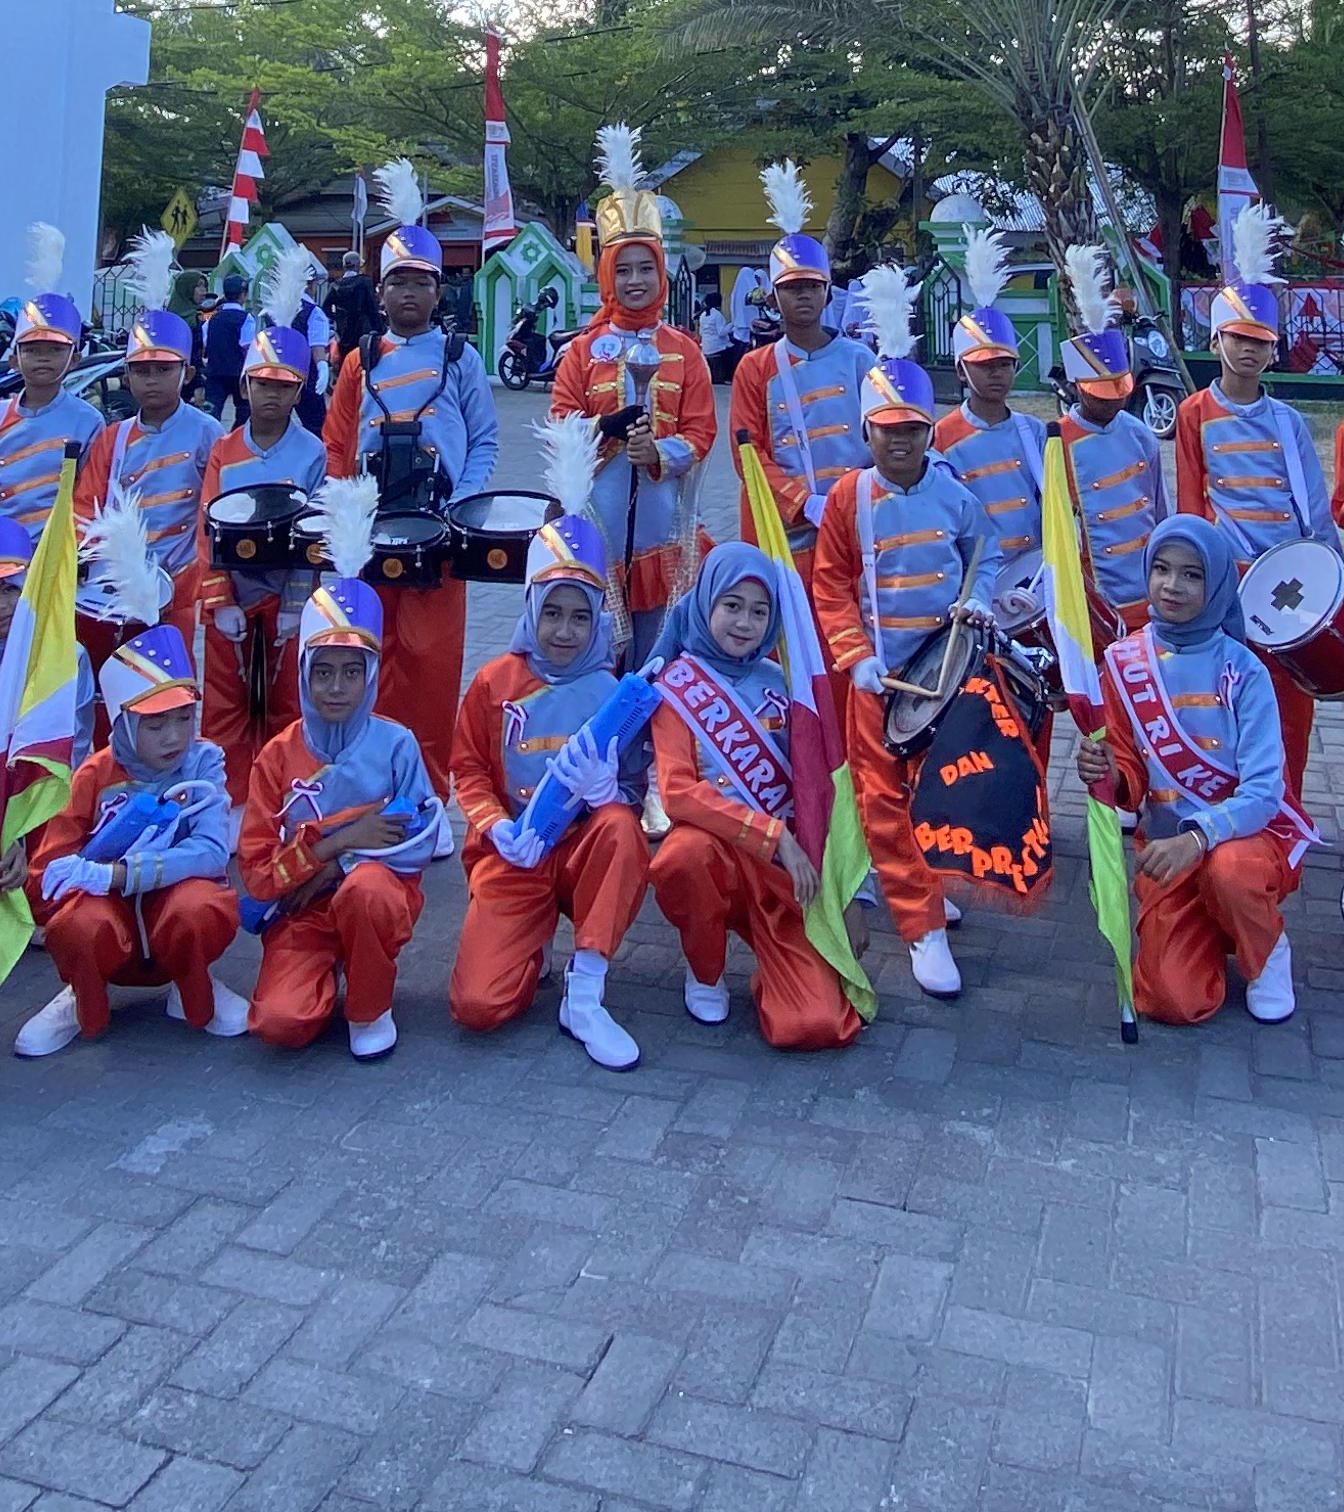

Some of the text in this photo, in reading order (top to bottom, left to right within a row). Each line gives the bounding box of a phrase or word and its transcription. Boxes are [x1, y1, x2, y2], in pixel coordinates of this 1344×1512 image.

[1112, 640, 1230, 798] HUT RI KE
[939, 751, 994, 786] DAN
